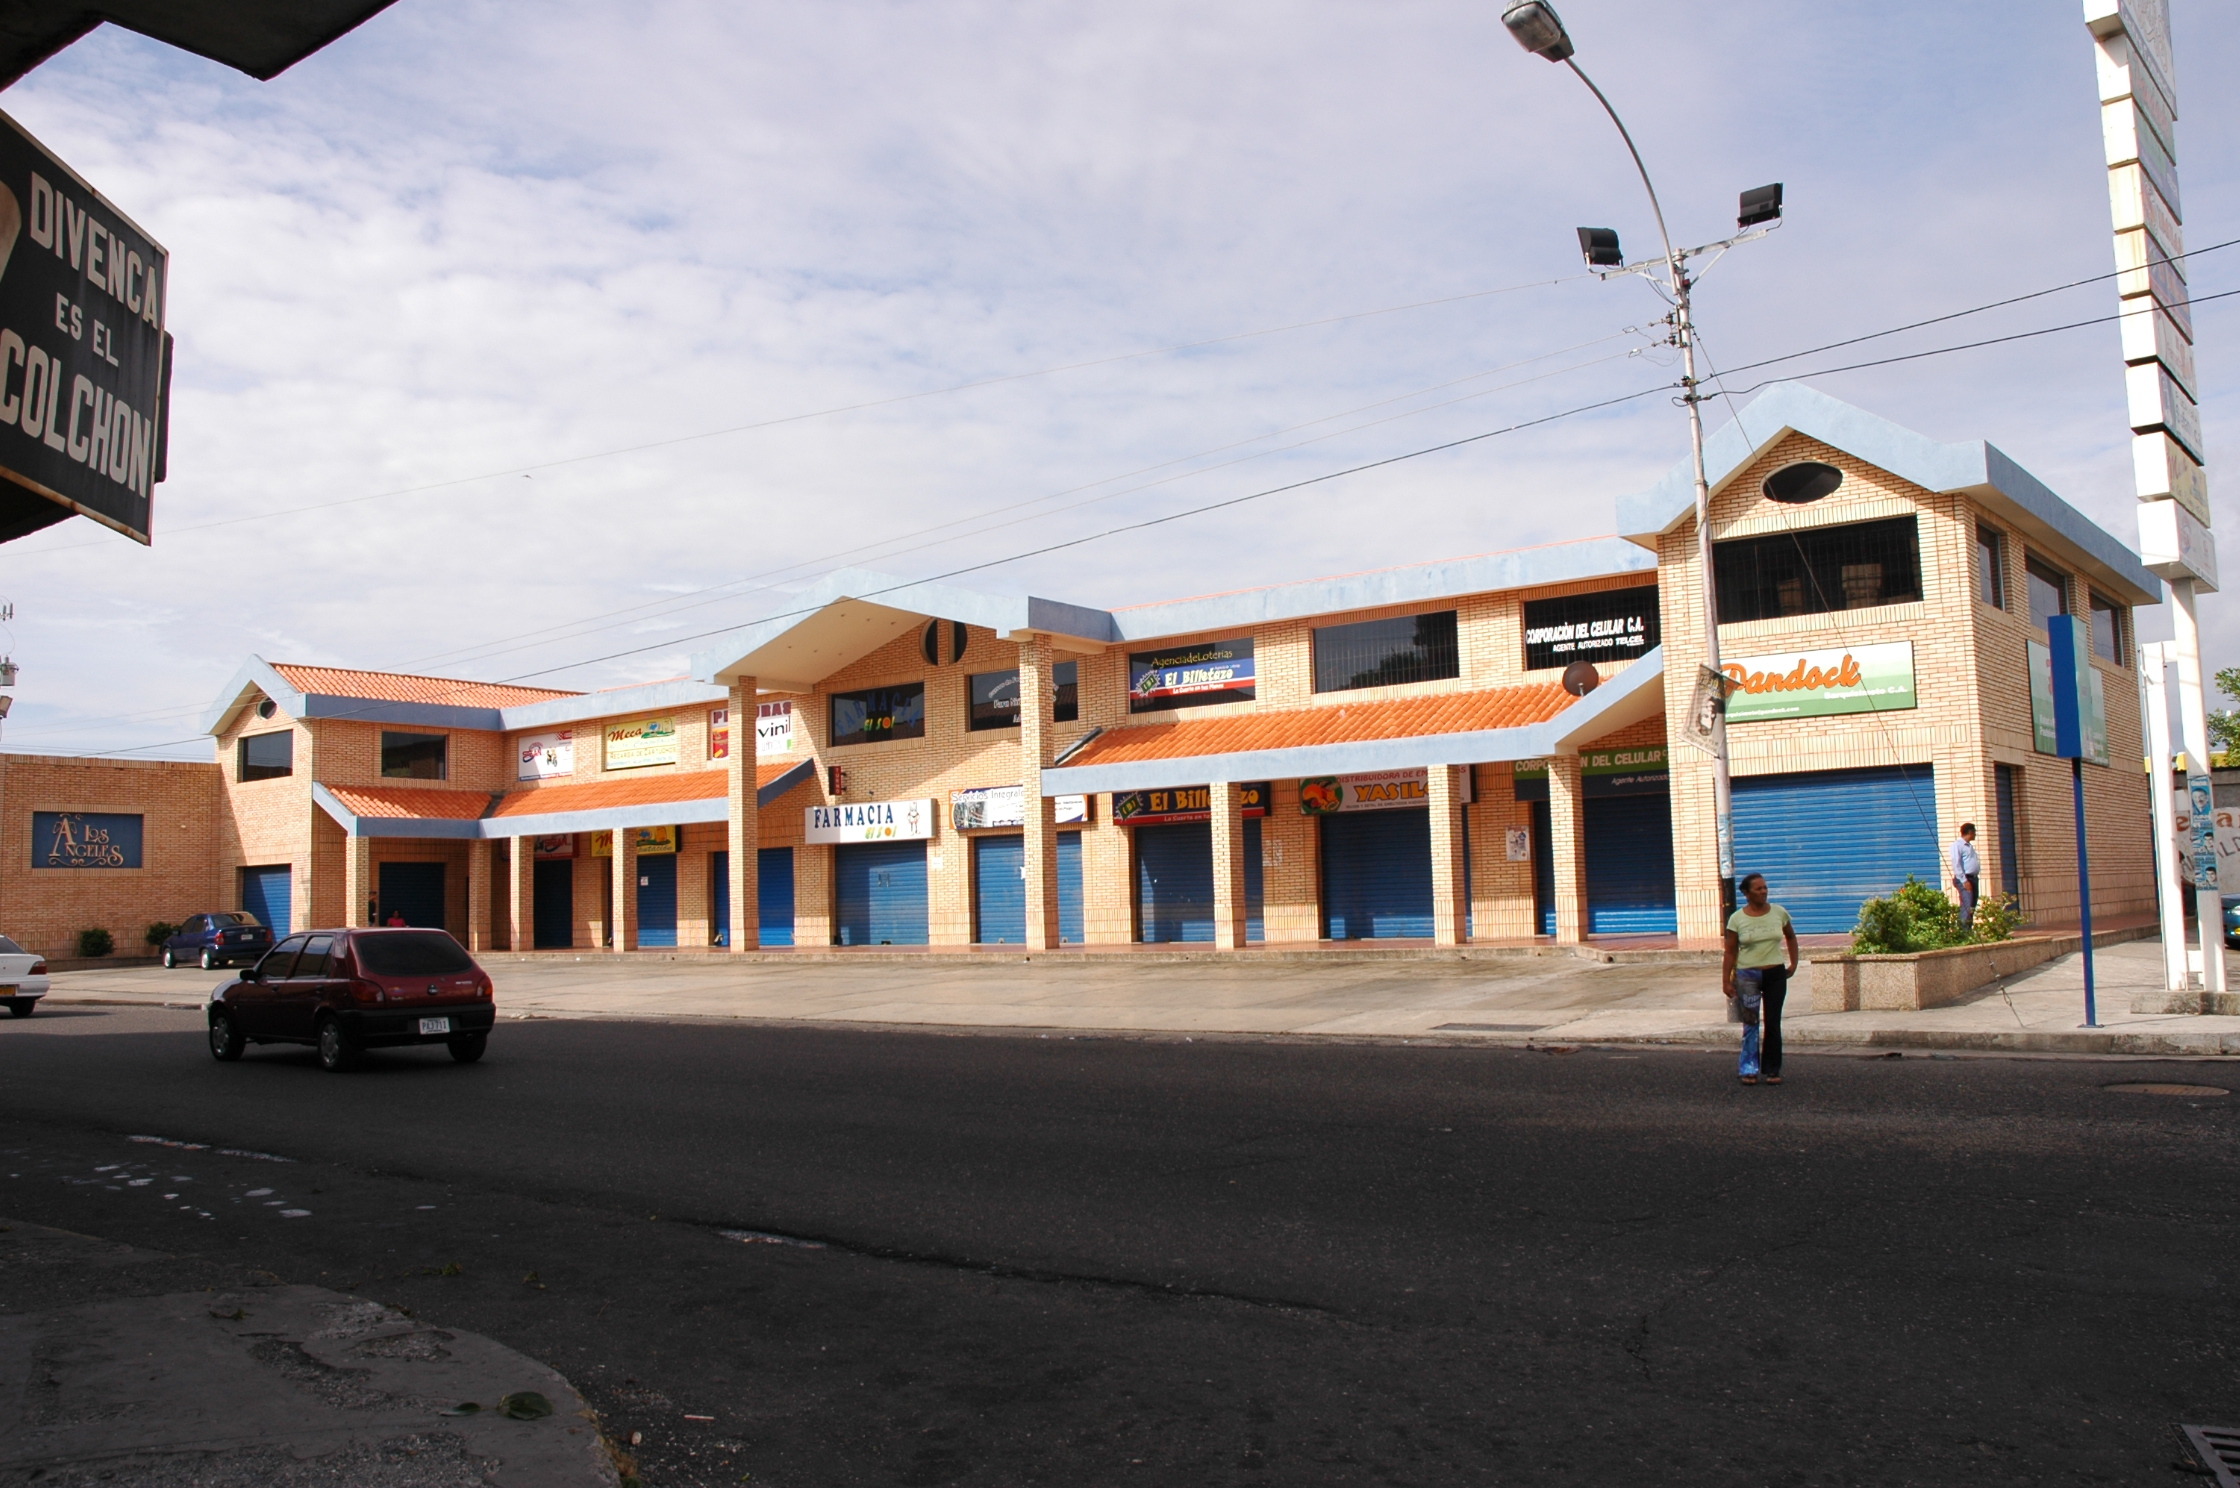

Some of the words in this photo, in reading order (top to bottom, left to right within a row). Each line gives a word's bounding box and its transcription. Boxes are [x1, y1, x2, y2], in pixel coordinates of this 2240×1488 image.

[30, 170, 159, 331] DIVENCA
[56, 292, 83, 341] ES
[93, 319, 119, 368] EL
[0, 327, 151, 499] COLCHON
[1575, 622, 1589, 639] DEL
[1590, 618, 1624, 637] CELULAR
[1627, 616, 1644, 632] C.A.
[1552, 642, 1575, 652] AGENTE
[1577, 637, 1614, 650] AUTORIZADO
[1164, 671, 1178, 687] El
[1182, 667, 1234, 685] Billetazo
[836, 689, 922, 736] FARMACIA
[1592, 755, 1611, 767] DEL
[1615, 750, 1661, 765] CELULAR
[1337, 771, 1400, 783] DISTRIBUIDORA
[1402, 769, 1414, 778] DE
[1149, 791, 1169, 812] El
[814, 803, 894, 829] FARMACIA
